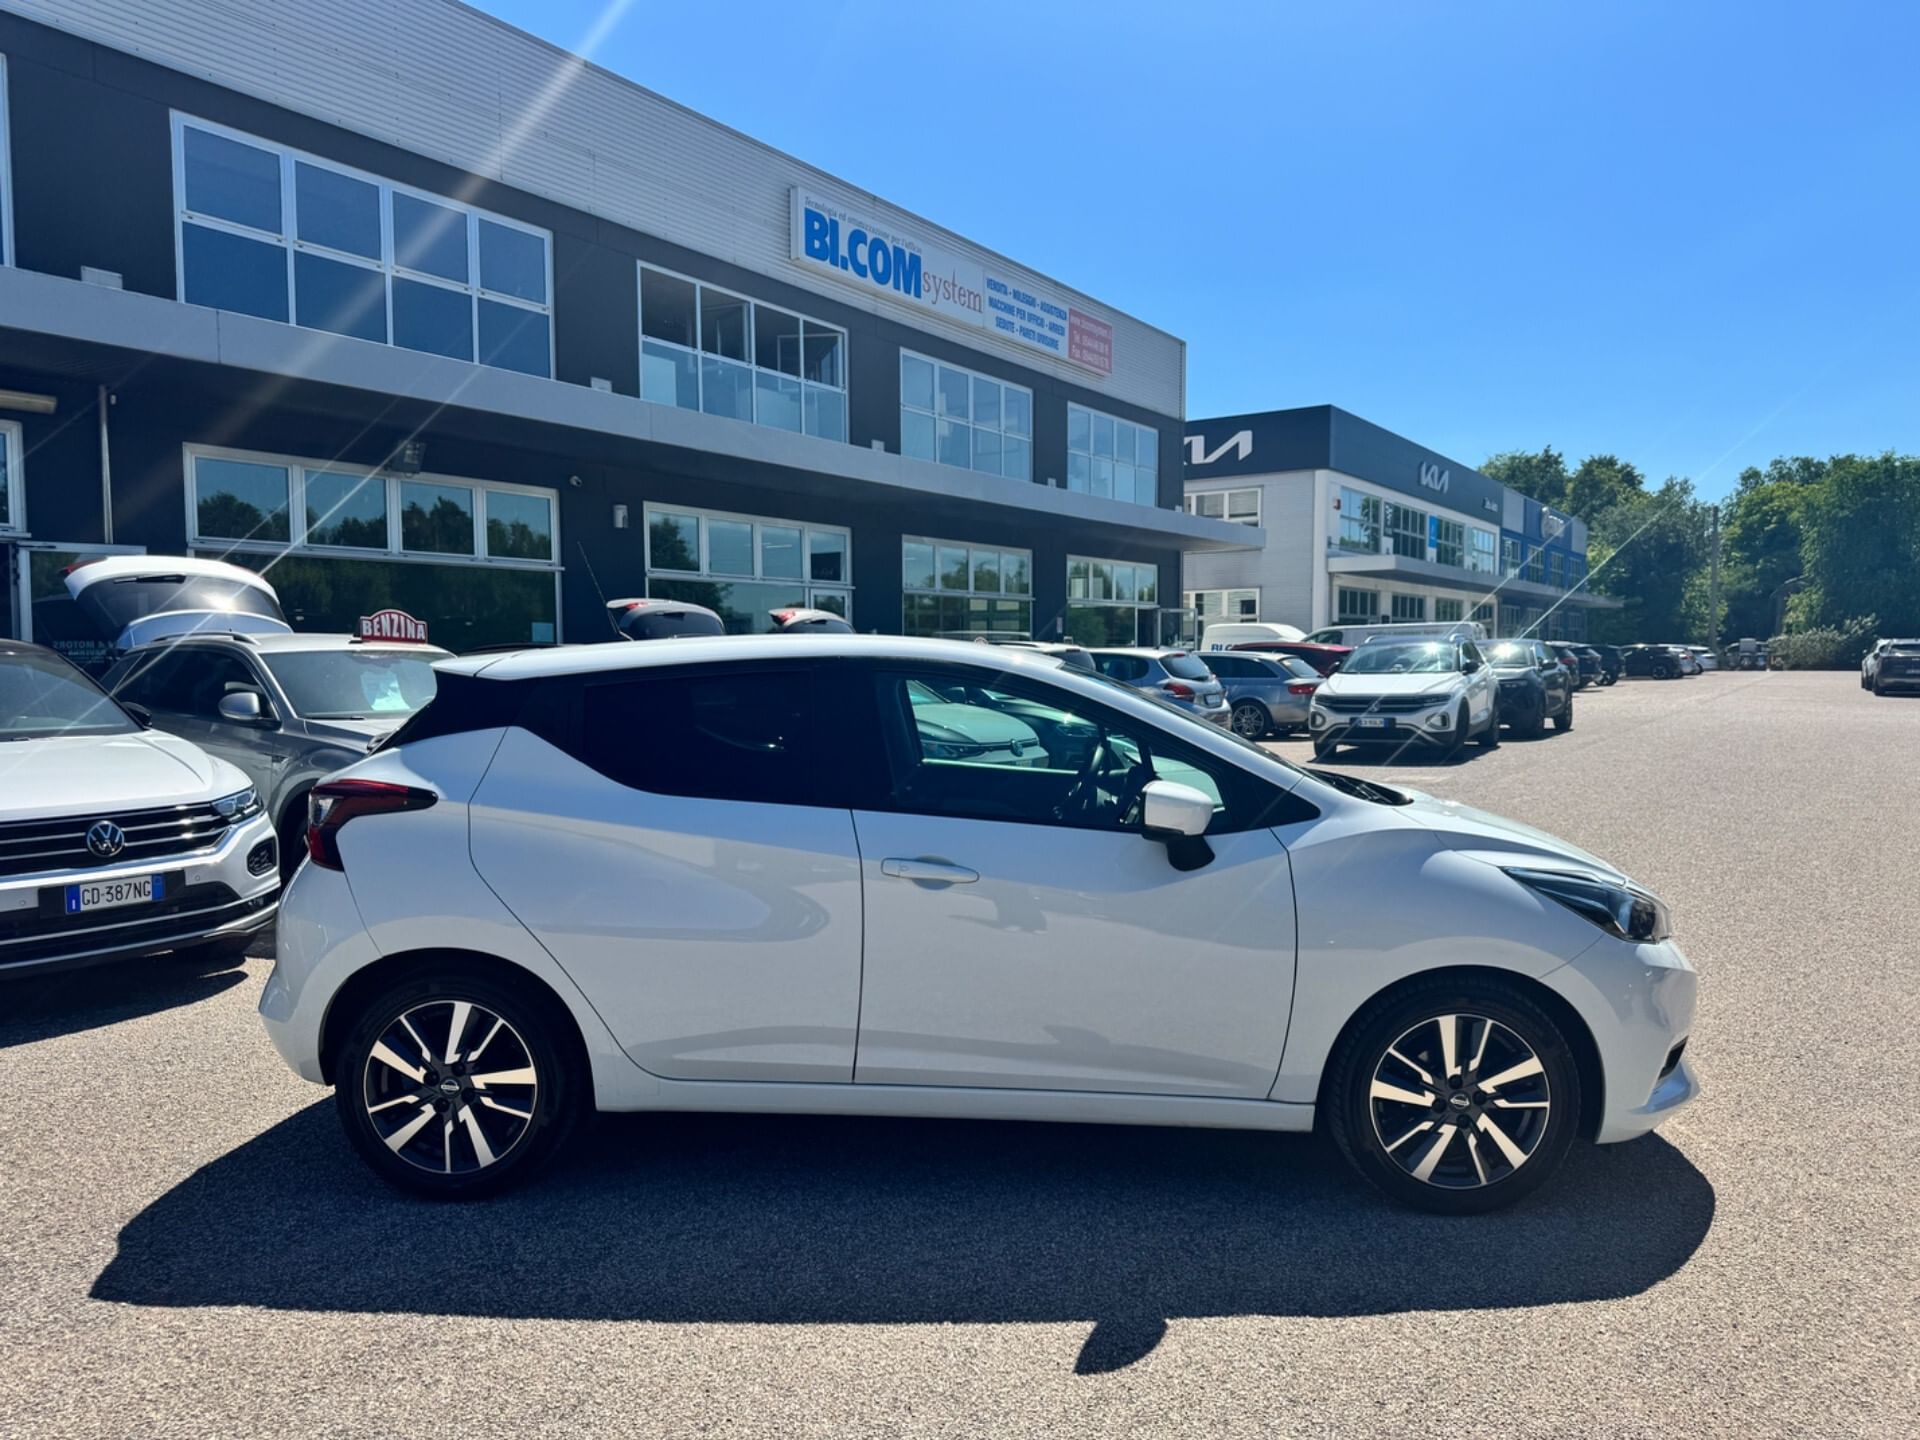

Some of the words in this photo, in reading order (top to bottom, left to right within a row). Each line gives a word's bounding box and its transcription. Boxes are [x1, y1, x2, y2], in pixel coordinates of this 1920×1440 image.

[804, 207, 922, 299] BI.COM
[922, 267, 983, 313] system
[986, 277, 1008, 296] VENDITA
[988, 296, 1015, 316] MACCHINE
[1016, 307, 1026, 320] PER
[362, 612, 426, 640] BENZINA
